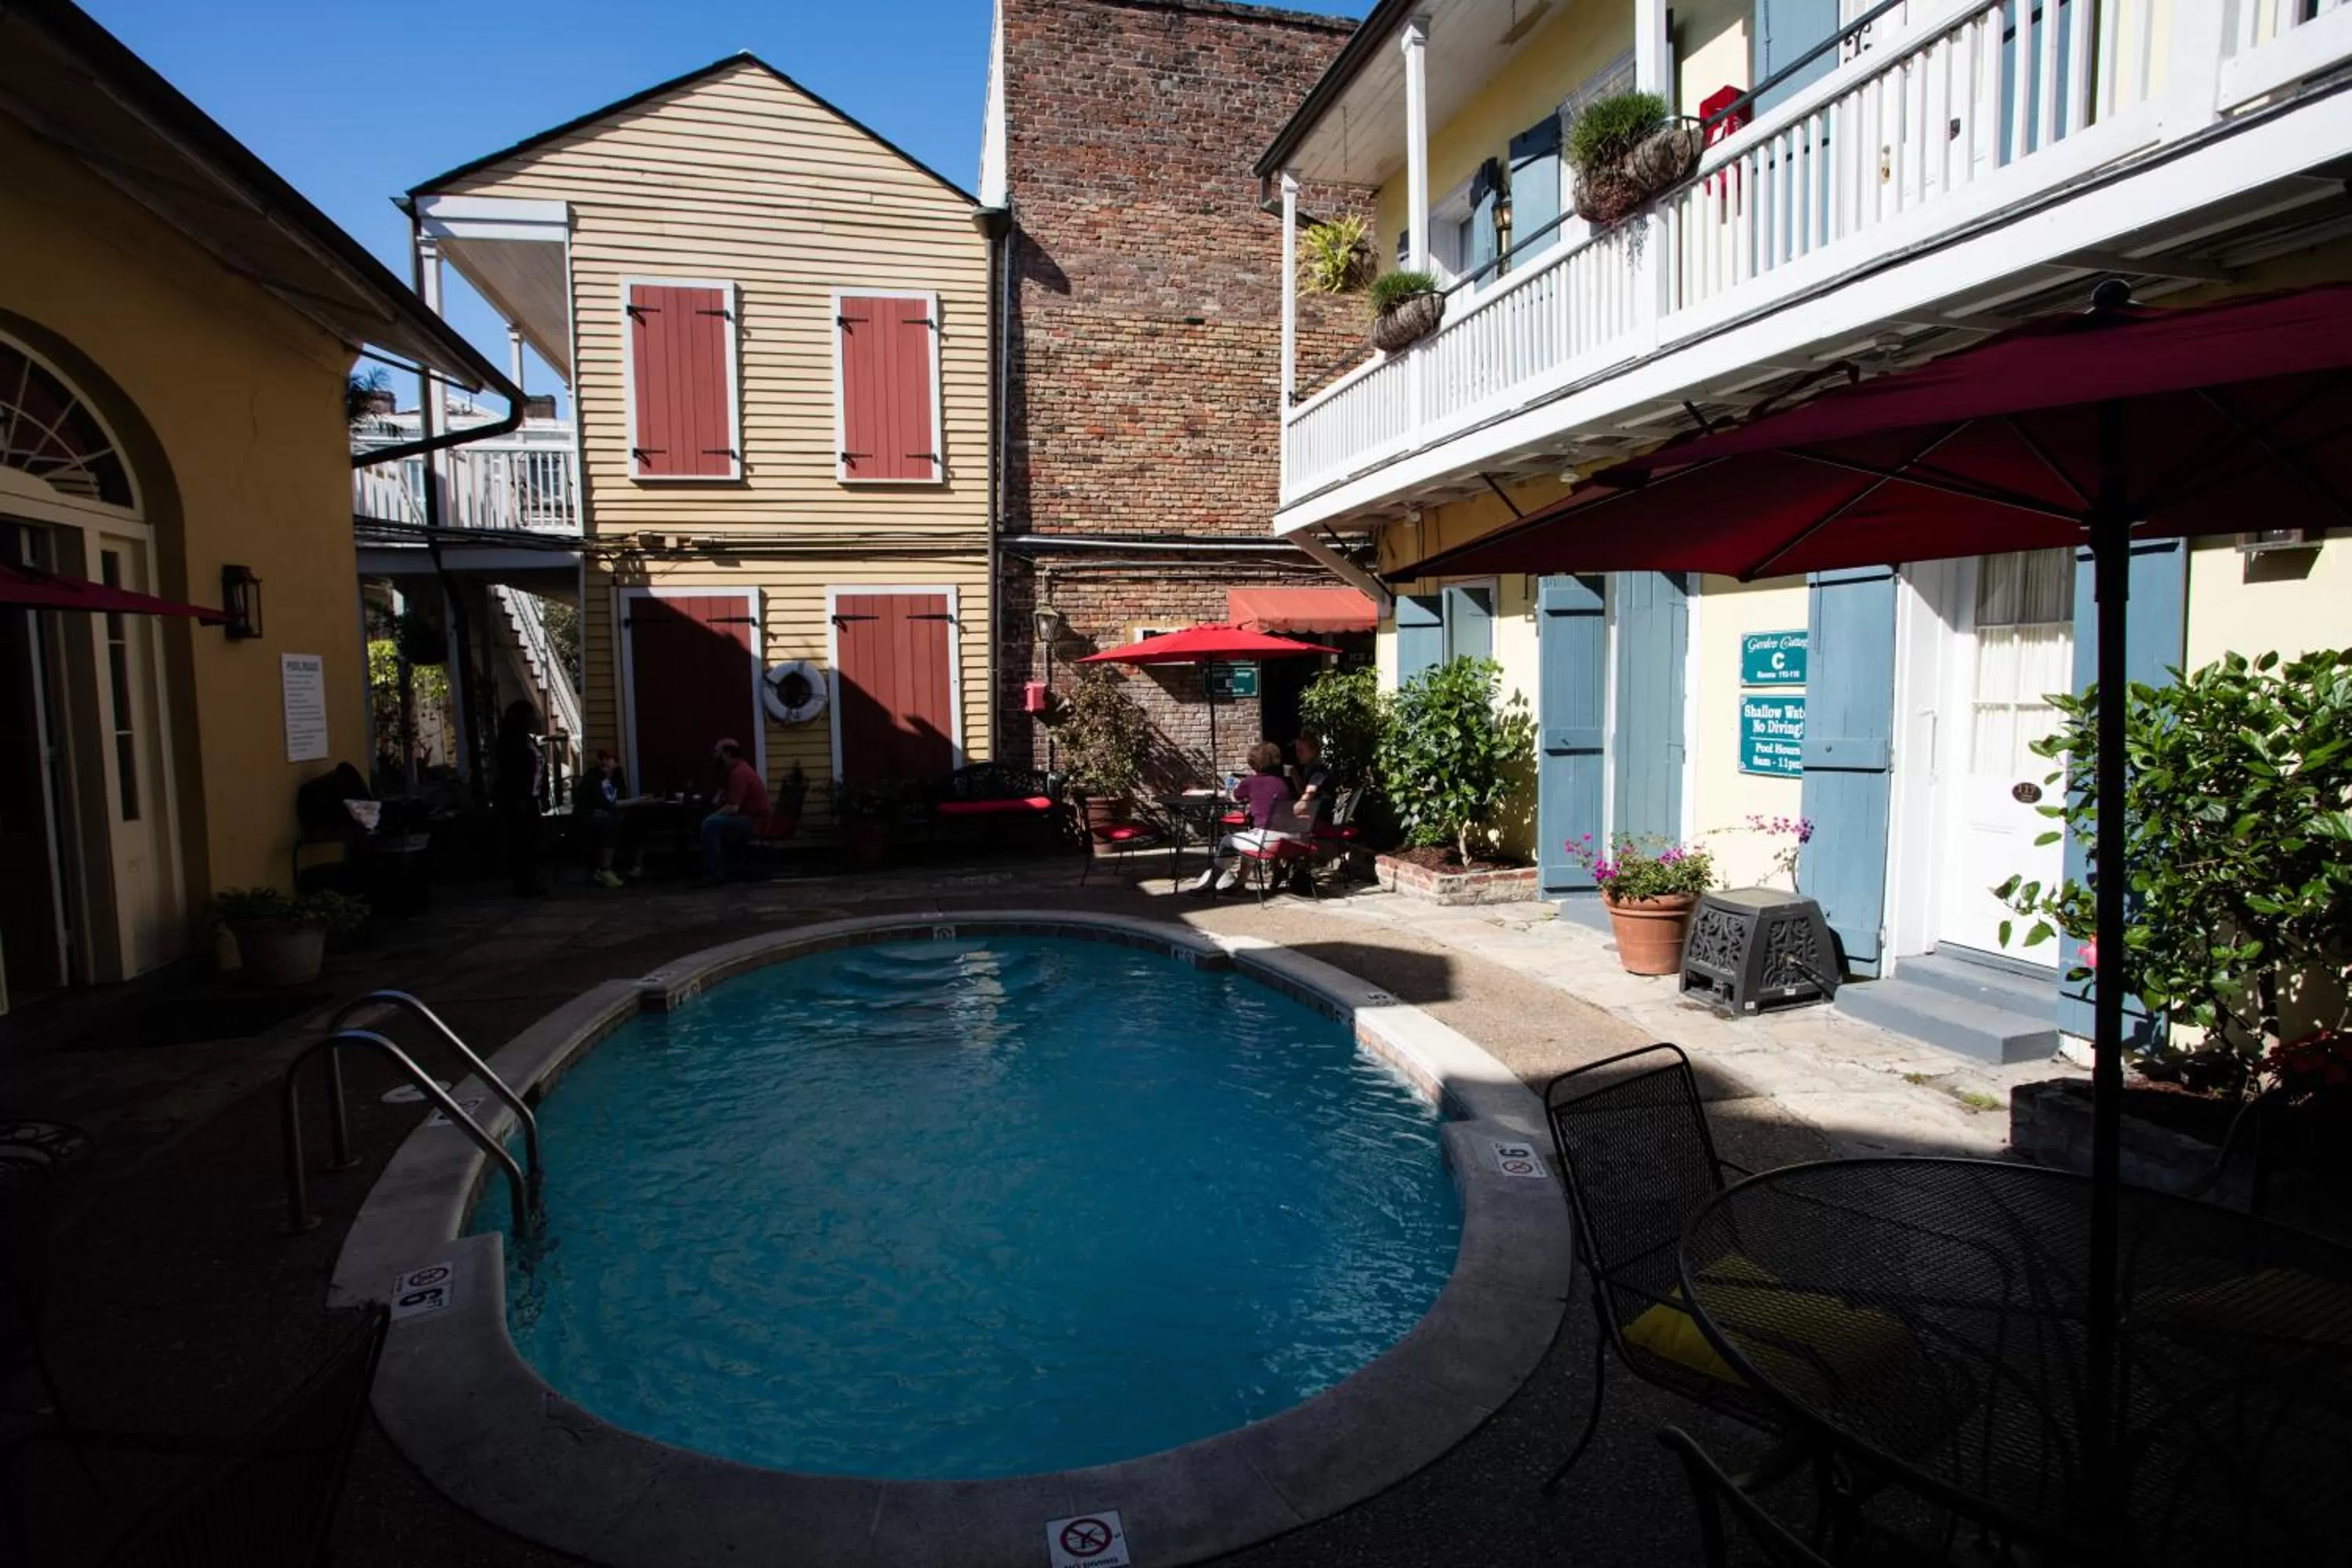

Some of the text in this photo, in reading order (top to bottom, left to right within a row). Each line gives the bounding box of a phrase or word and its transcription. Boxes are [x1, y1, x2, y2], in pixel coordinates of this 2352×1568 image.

[1771, 652, 1785, 670] C
[1225, 678, 1234, 688] E
[1744, 704, 1781, 718] Shallow
[1752, 719, 1804, 739] No Diving!
[1755, 742, 1773, 753] Pool
